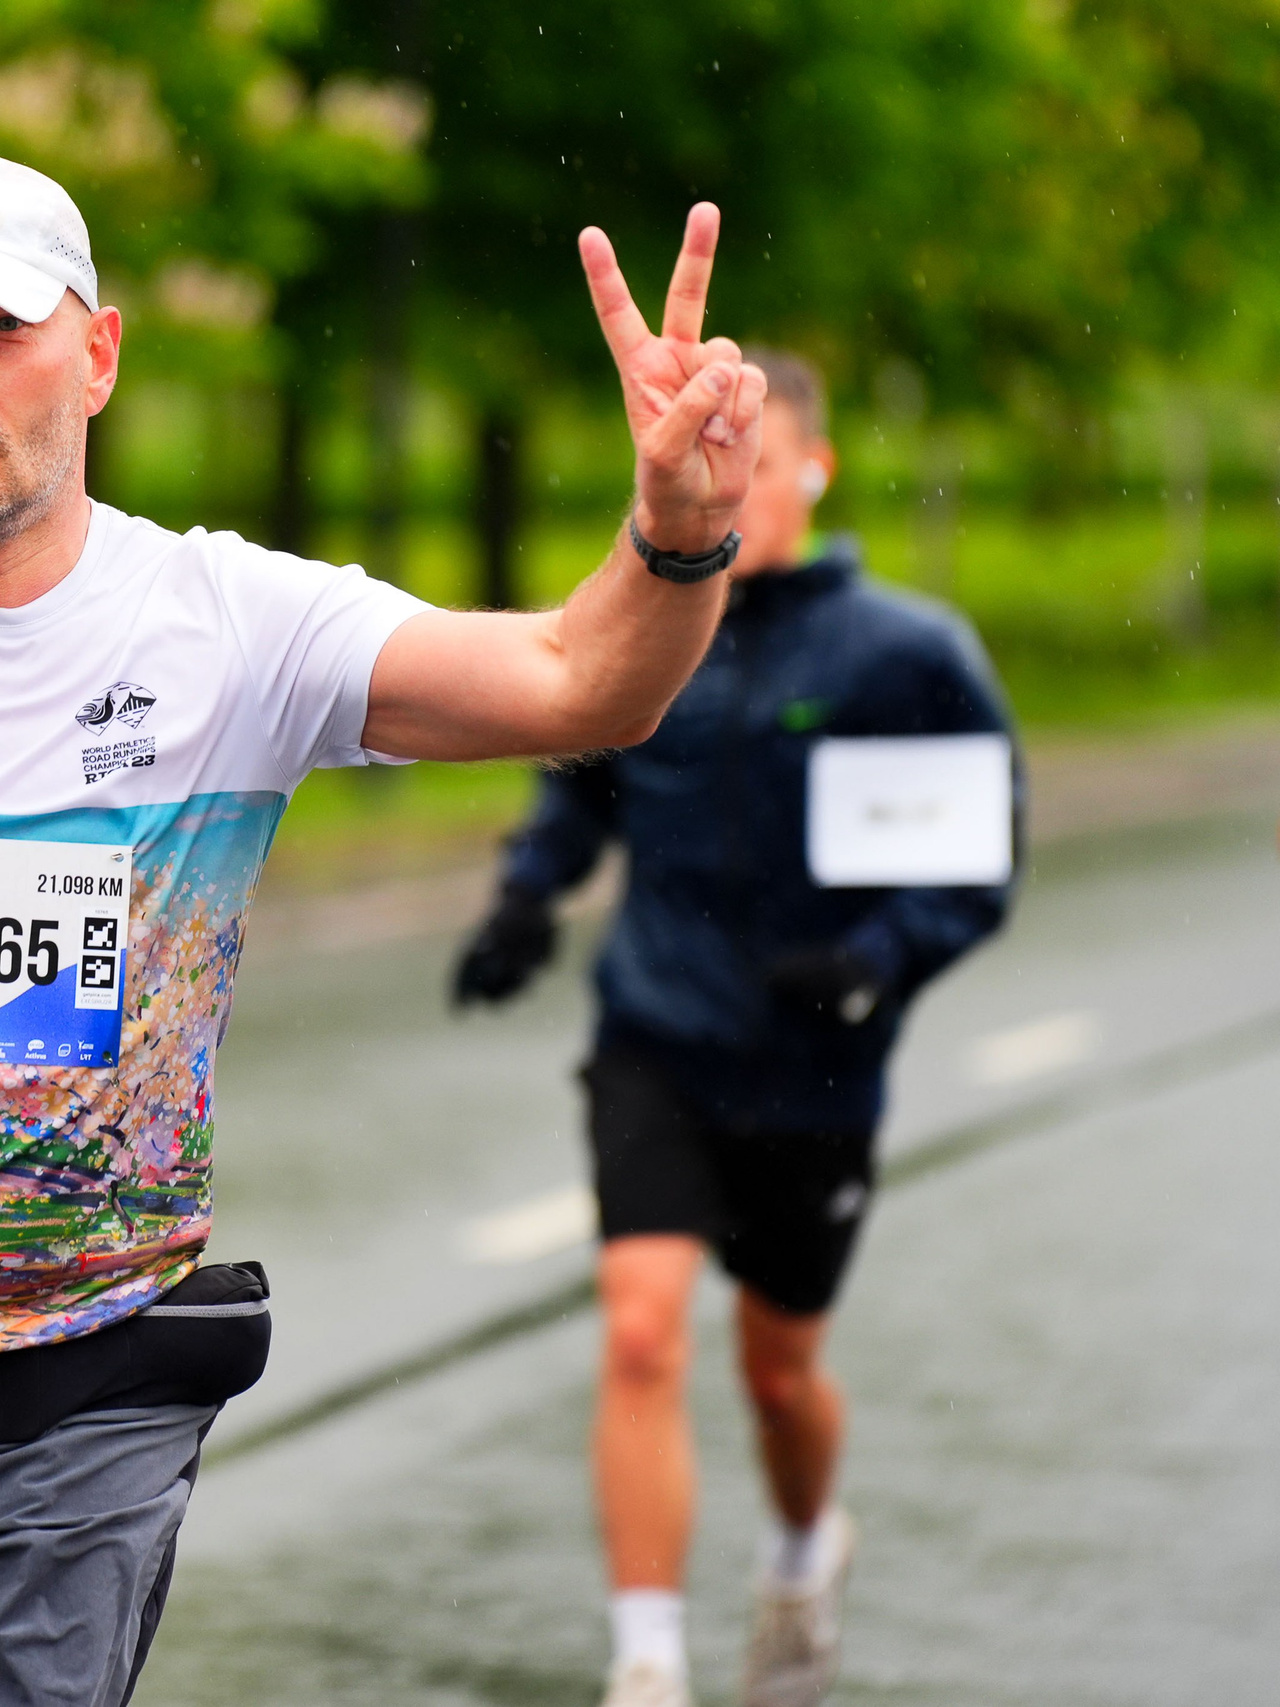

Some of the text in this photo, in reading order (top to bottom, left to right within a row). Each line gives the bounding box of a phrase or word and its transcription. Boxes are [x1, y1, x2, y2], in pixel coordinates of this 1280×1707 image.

[82, 745, 111, 754] WORLD
[82, 753, 111, 764] ROAD
[131, 754, 156, 767] 23
[37, 873, 123, 897] 21,098 KM
